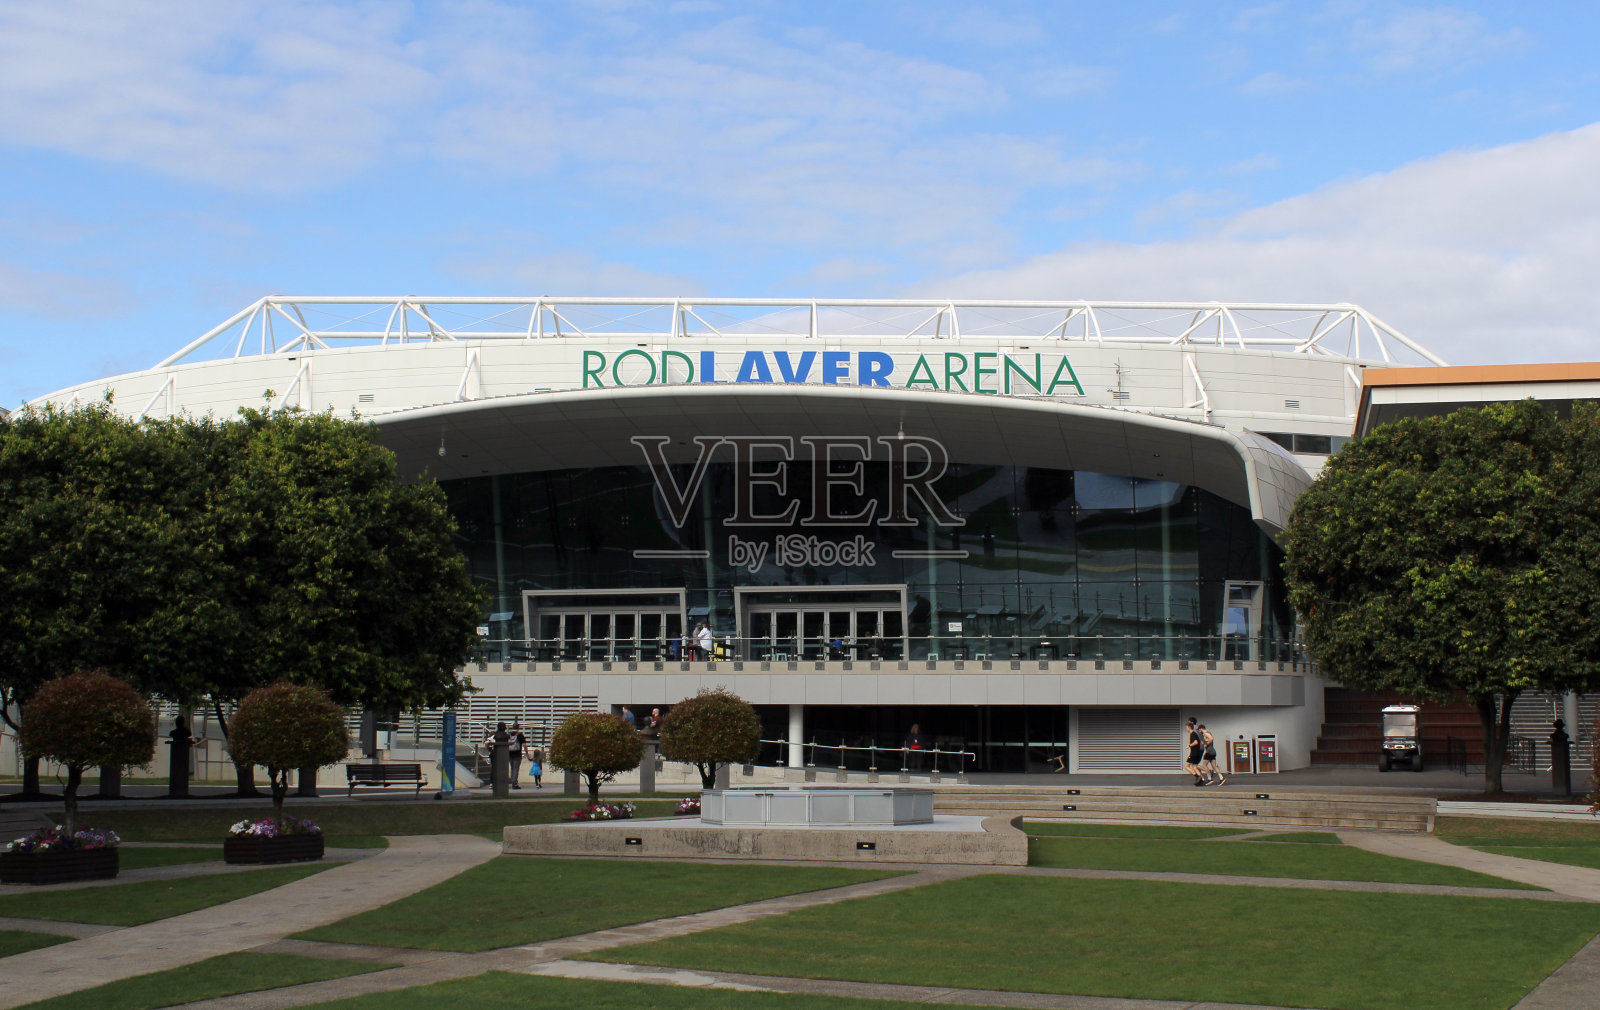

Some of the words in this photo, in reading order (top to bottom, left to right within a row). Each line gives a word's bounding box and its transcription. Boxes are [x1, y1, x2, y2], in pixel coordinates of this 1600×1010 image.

[582, 349, 694, 389] ROD
[700, 350, 894, 388] LAVER
[905, 351, 1085, 396] ARENA
